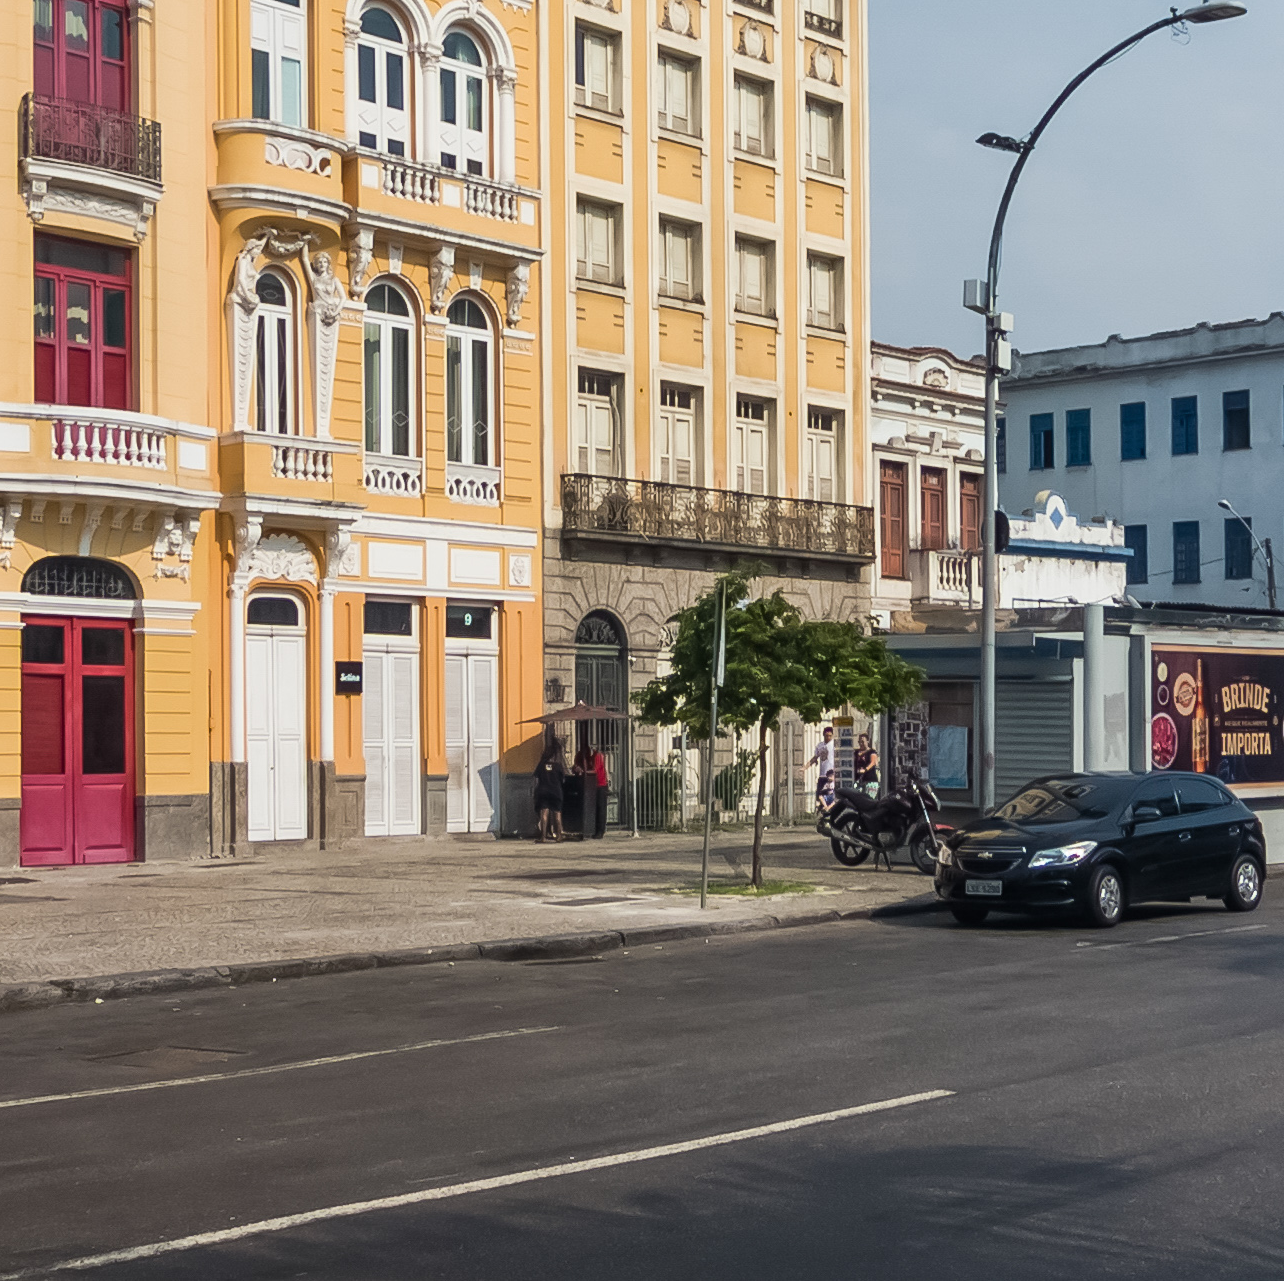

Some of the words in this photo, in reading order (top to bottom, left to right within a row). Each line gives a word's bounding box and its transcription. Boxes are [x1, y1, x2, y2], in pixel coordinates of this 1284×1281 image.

[464, 612, 472, 626] 9
[1221, 682, 1271, 714] BRINDE
[1221, 732, 1272, 756] IMPORTA
